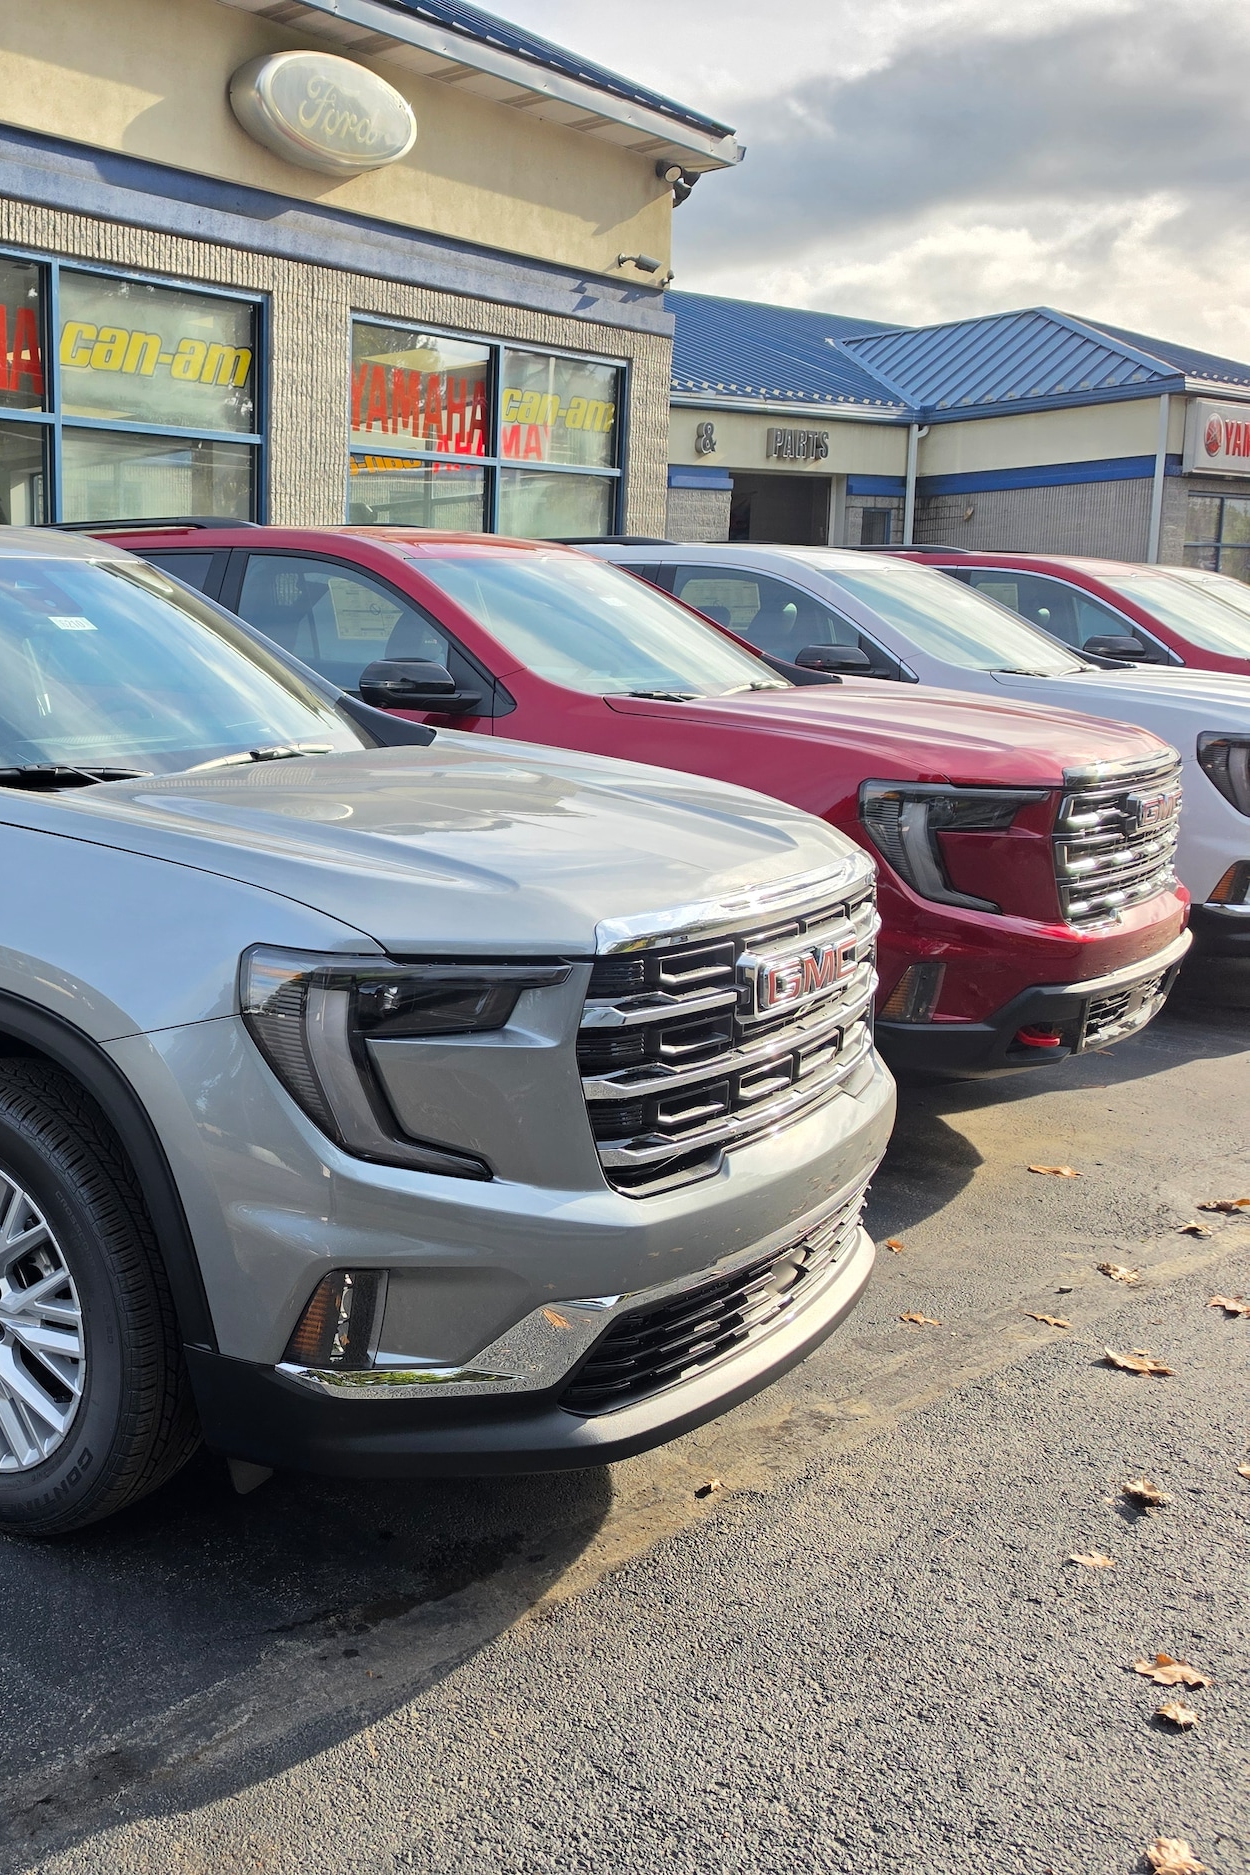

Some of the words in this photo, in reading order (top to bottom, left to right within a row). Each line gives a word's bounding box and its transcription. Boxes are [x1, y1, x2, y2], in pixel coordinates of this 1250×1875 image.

[299, 75, 382, 144] Ford
[60, 320, 253, 388] can-am
[351, 362, 489, 444] YAMAHA
[501, 387, 615, 433] can-am
[698, 421, 717, 454] &
[768, 427, 829, 460] PARTS
[1142, 791, 1183, 824] GMC
[767, 934, 858, 1007] GMC
